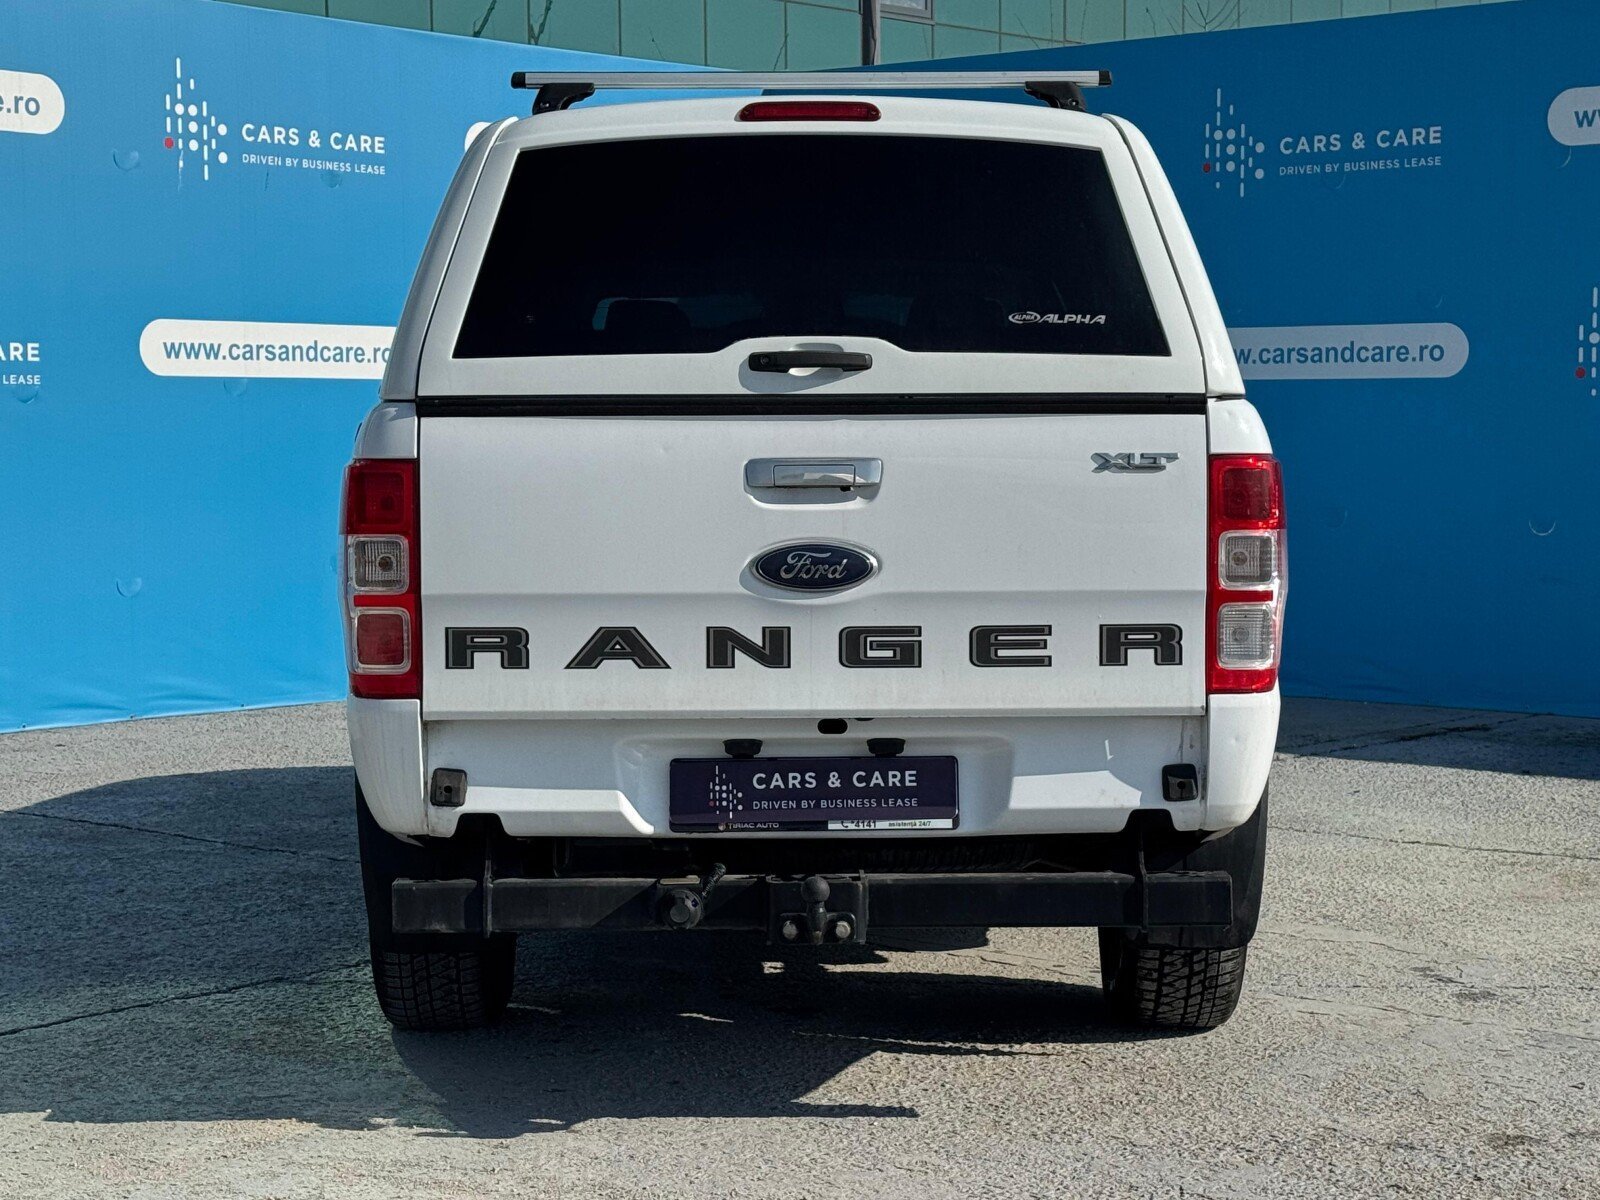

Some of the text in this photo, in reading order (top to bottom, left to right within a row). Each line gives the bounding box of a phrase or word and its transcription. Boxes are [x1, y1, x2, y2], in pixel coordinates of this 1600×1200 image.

[0, 94, 40, 116] .ro
[241, 123, 386, 154] CARS & CARE
[1279, 126, 1442, 155] CARS & CARE
[242, 153, 386, 175] DRIVEN BY BUSINESS LEASE
[1279, 156, 1442, 176] DRIVEN BY BUSINESS LEASE
[1038, 313, 1107, 325] ALPHA
[163, 340, 391, 364] www.carsandcare.ro
[2, 374, 41, 385] LEASE
[1091, 452, 1180, 474] XLT
[780, 551, 848, 579] Ford
[444, 624, 1184, 670] RANGER
[752, 770, 918, 790] CARS & CARE
[753, 797, 919, 810] DRIVEN BY BUSINESS LEASE
